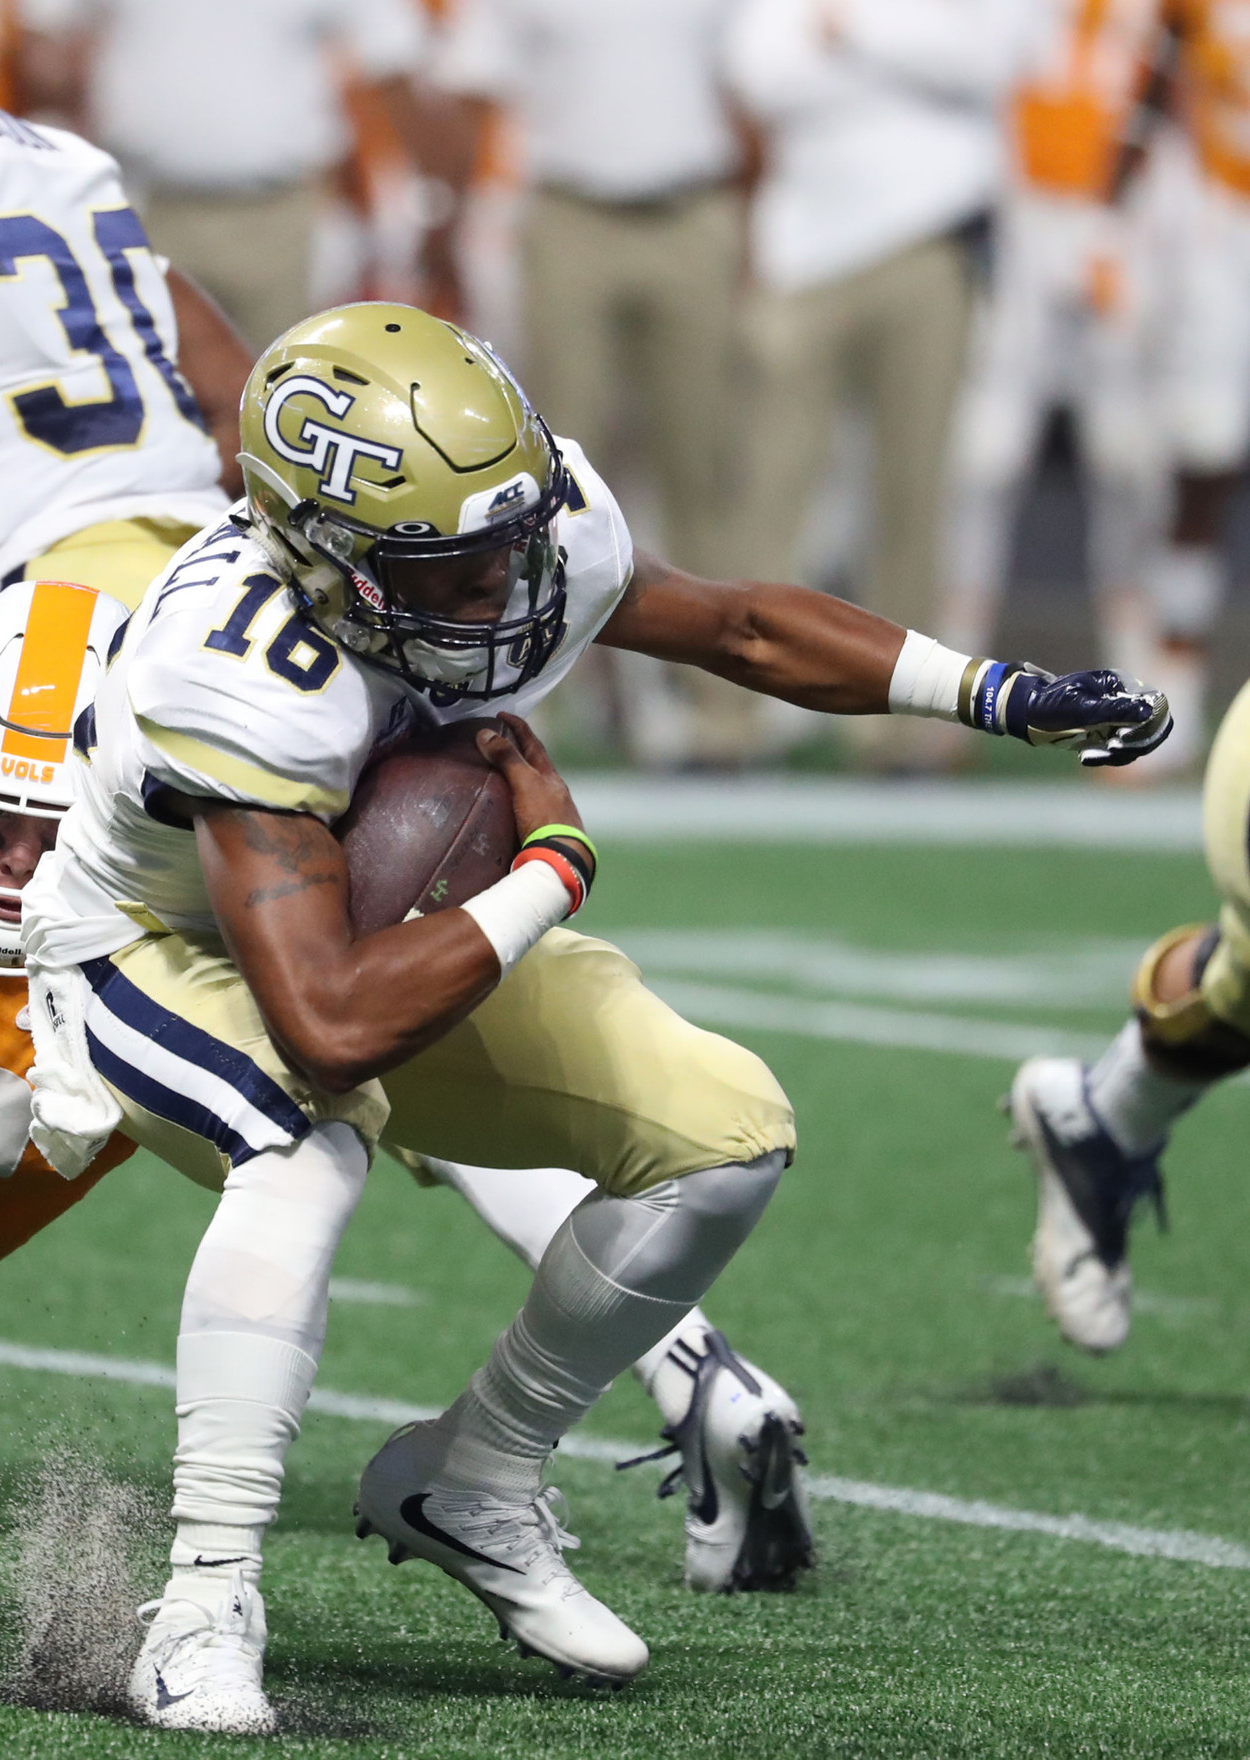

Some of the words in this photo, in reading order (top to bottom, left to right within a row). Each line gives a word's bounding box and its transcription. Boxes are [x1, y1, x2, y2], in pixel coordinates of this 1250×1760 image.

[263, 374, 405, 506] GT
[487, 480, 525, 511] ACC
[199, 570, 344, 697] 16
[983, 685, 996, 712] 104.7
[0, 756, 55, 783] VOLS
